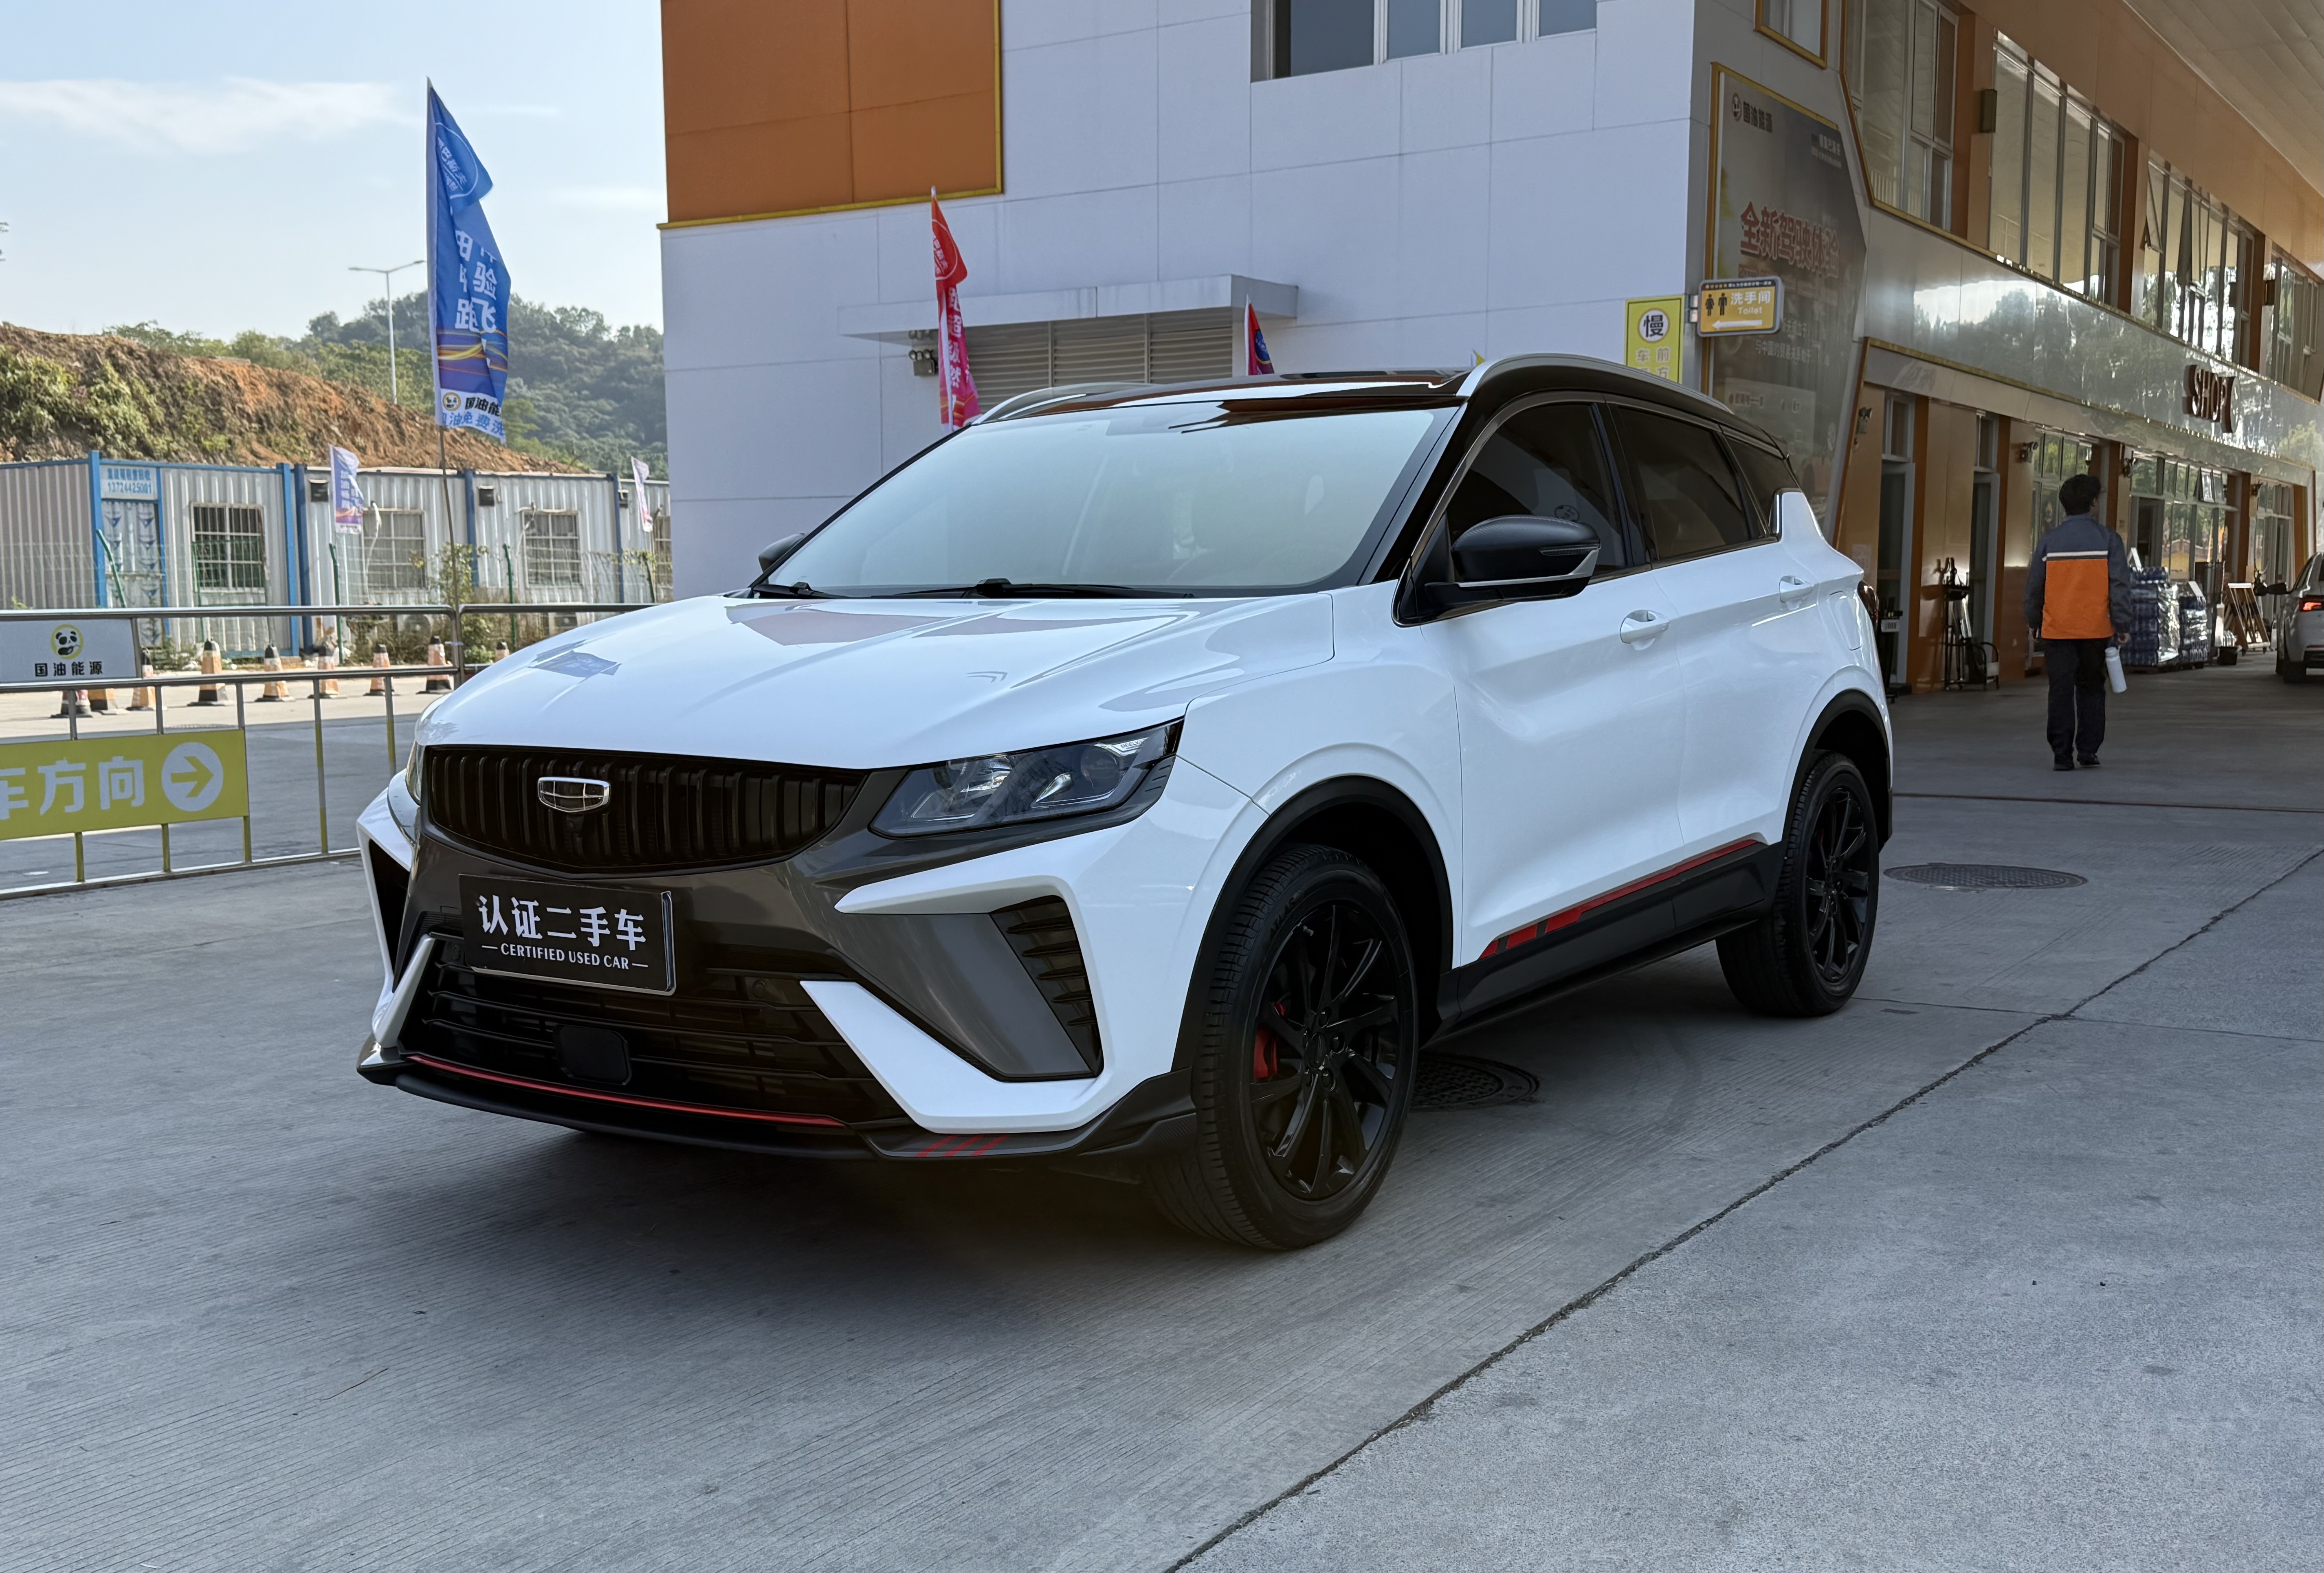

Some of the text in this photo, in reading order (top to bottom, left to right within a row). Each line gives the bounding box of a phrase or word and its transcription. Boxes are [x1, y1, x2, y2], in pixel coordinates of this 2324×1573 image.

[1740, 201, 1839, 278] 全新驾驶体验
[1730, 290, 1771, 305] 洗手间
[1738, 306, 1762, 315] Toilet
[1643, 314, 1664, 338] 慢
[2186, 365, 2227, 423] SHOP
[35, 661, 103, 677] 国油能源
[478, 895, 646, 951] 认证二手车
[501, 943, 629, 970] CERTIFIED USED CAR
